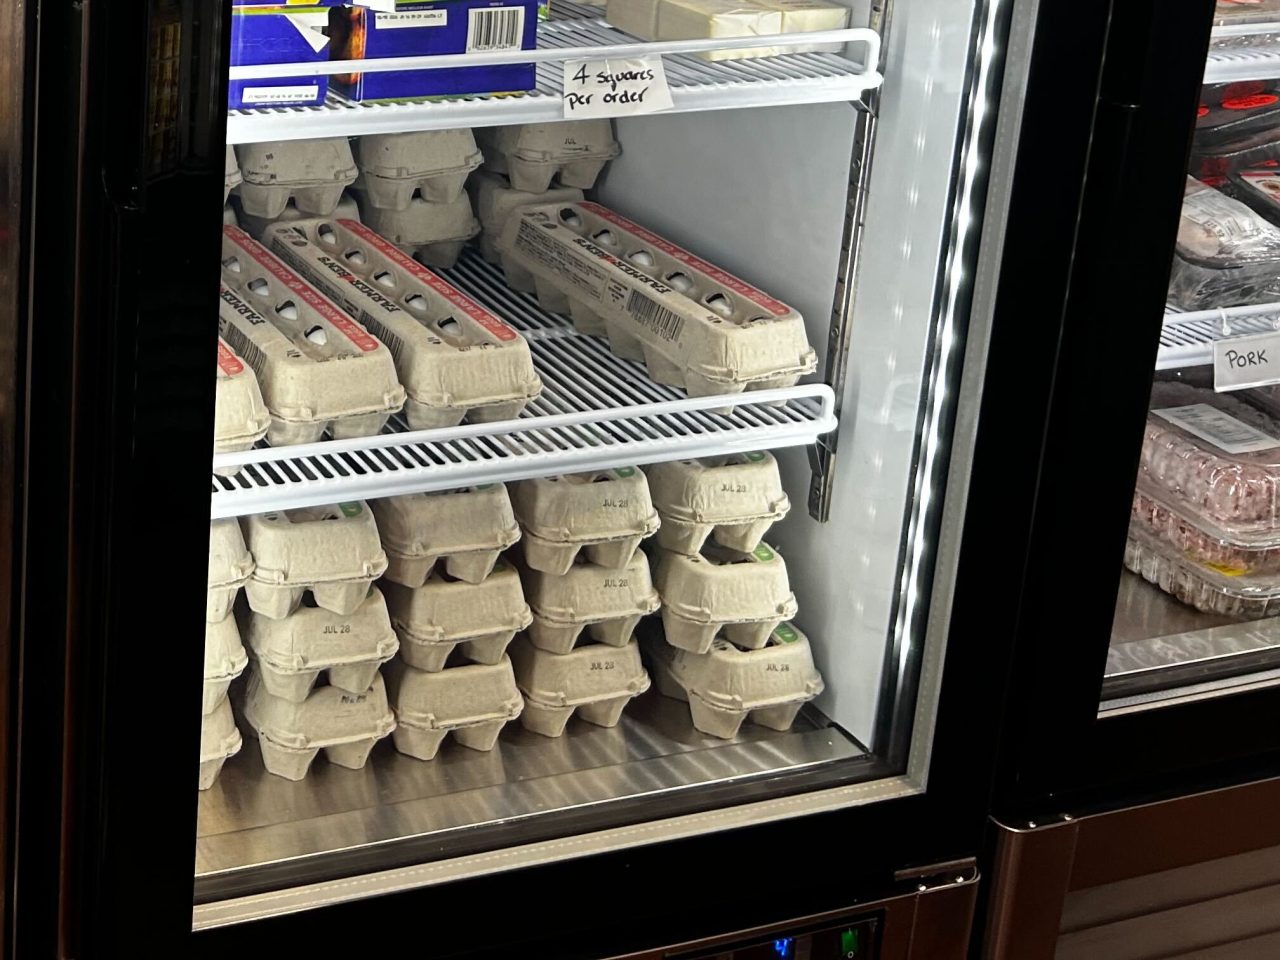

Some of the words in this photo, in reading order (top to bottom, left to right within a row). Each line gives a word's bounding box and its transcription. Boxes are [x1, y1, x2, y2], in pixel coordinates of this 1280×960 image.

[572, 65, 591, 85] 4
[597, 67, 655, 92] squares
[565, 93, 592, 112] per
[602, 87, 648, 105] order
[614, 260, 672, 295] FARMER
[351, 277, 401, 313] FARMER
[449, 291, 482, 317] LARGE
[1224, 349, 1269, 369] PORK
[720, 483, 736, 493] JUL
[602, 499, 618, 509] JUL
[603, 578, 618, 589] JUL
[322, 624, 338, 634] JUL
[339, 623, 351, 633] 28
[589, 661, 604, 671] JUL
[766, 662, 780, 672] JUL
